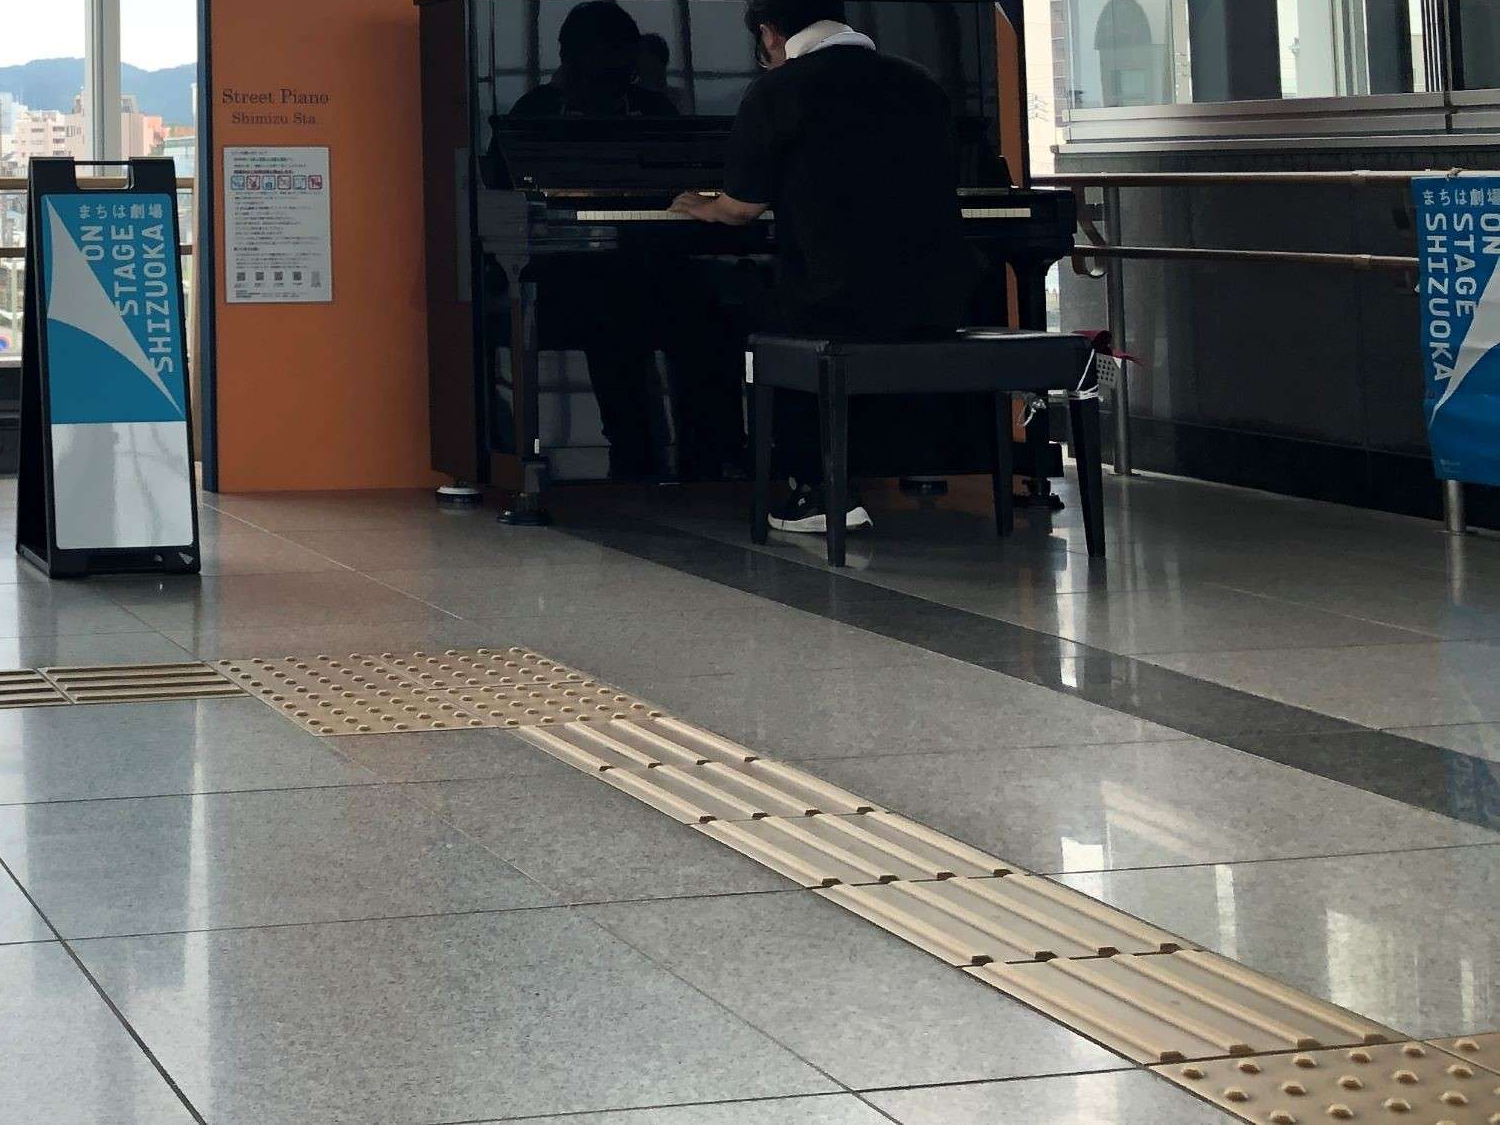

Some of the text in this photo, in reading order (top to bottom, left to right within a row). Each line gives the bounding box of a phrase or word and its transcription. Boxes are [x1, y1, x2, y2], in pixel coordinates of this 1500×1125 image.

[222, 88, 330, 105] Street Piano
[231, 111, 288, 125] Shimizu
[79, 203, 164, 220] まちは劇場
[1423, 188, 1500, 206] まちは劇場
[79, 225, 105, 261] ON
[1480, 213, 1500, 254] ON
[111, 225, 139, 316] STAGE
[1453, 213, 1477, 317] STAGE
[142, 225, 174, 373] SHIZUOKA
[1425, 213, 1455, 381] SHIZUOKA
